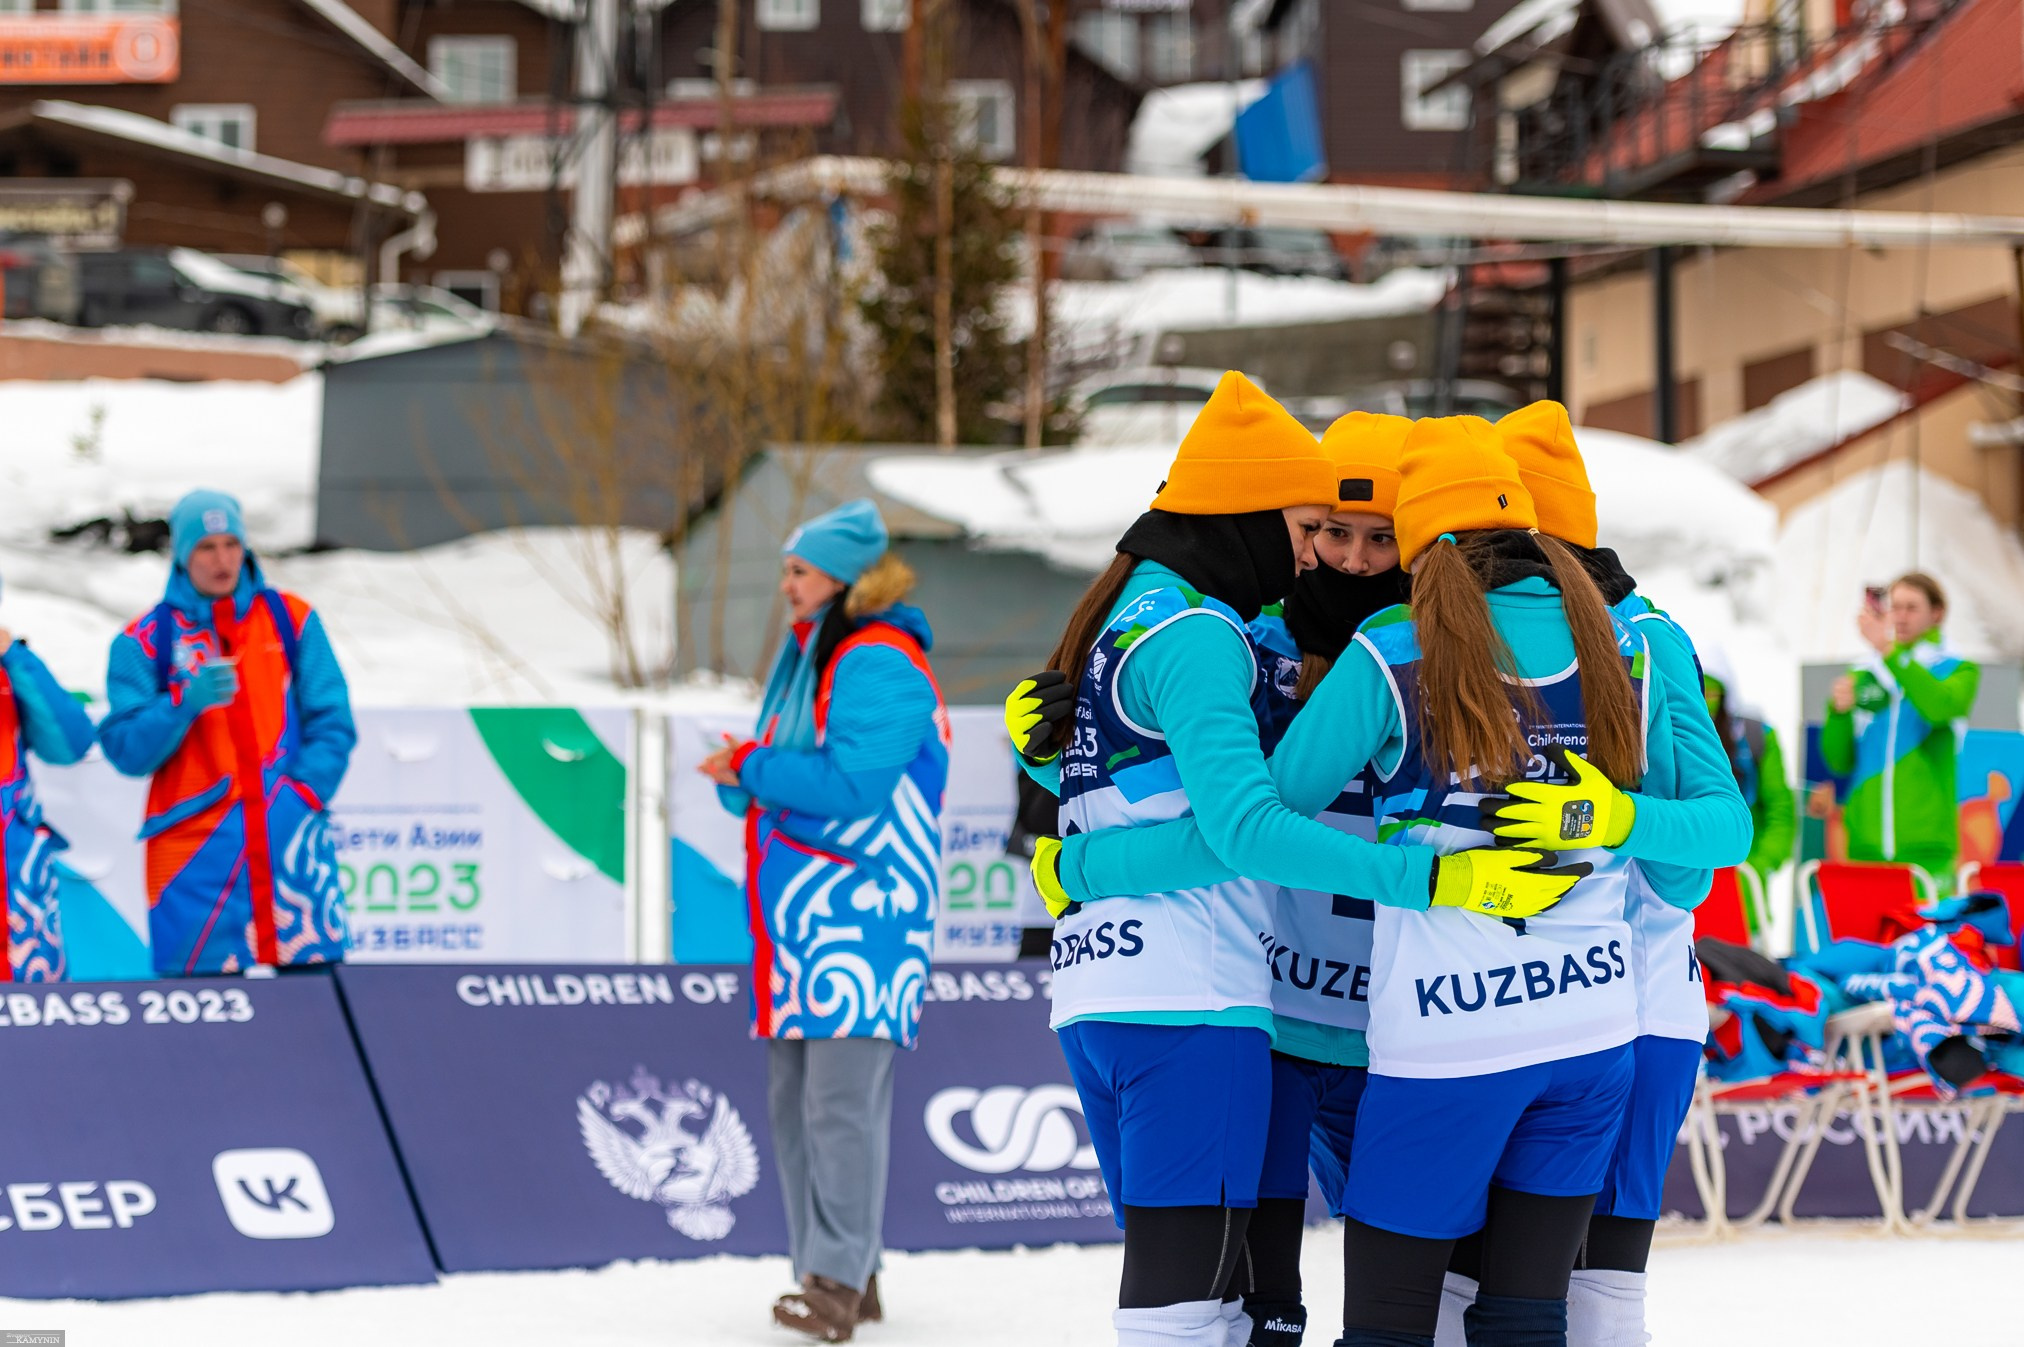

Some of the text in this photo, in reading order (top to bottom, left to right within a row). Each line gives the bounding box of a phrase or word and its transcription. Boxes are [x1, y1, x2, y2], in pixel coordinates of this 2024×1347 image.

[1527, 733, 1579, 747] Children
[410, 822, 482, 848] Азии
[1051, 919, 1144, 974] ZBASS
[456, 972, 739, 1007] CHILDREN OF
[1415, 940, 1625, 1018] KUZBASS
[137, 988, 255, 1025] 2023
[935, 1177, 1067, 1206] CHILDREN
[1065, 1175, 1100, 1200] OF
[945, 1202, 1081, 1225] INTERNATIONAL
